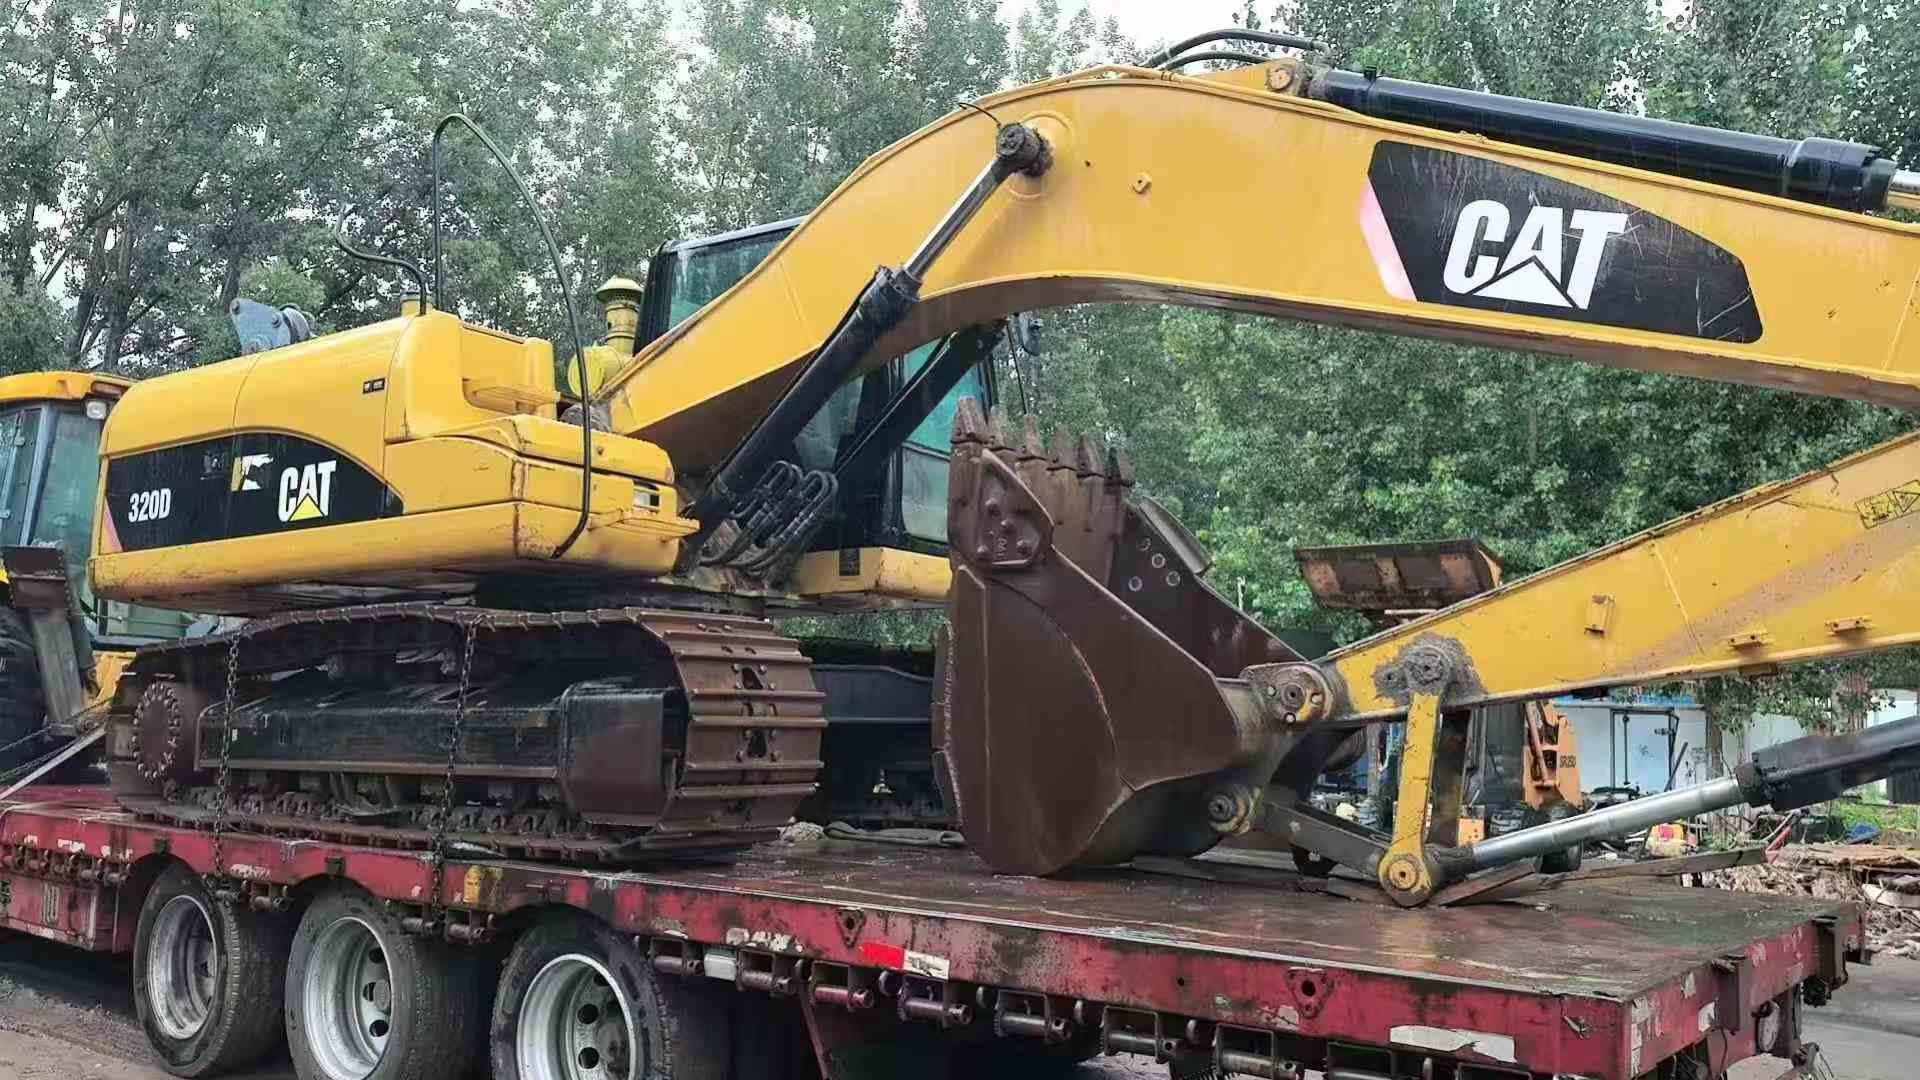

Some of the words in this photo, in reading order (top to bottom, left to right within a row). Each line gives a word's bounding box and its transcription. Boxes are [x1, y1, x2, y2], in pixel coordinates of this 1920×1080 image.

[1443, 199, 1629, 310] CAT
[128, 488, 171, 523] 320D
[278, 460, 337, 522] CAT
